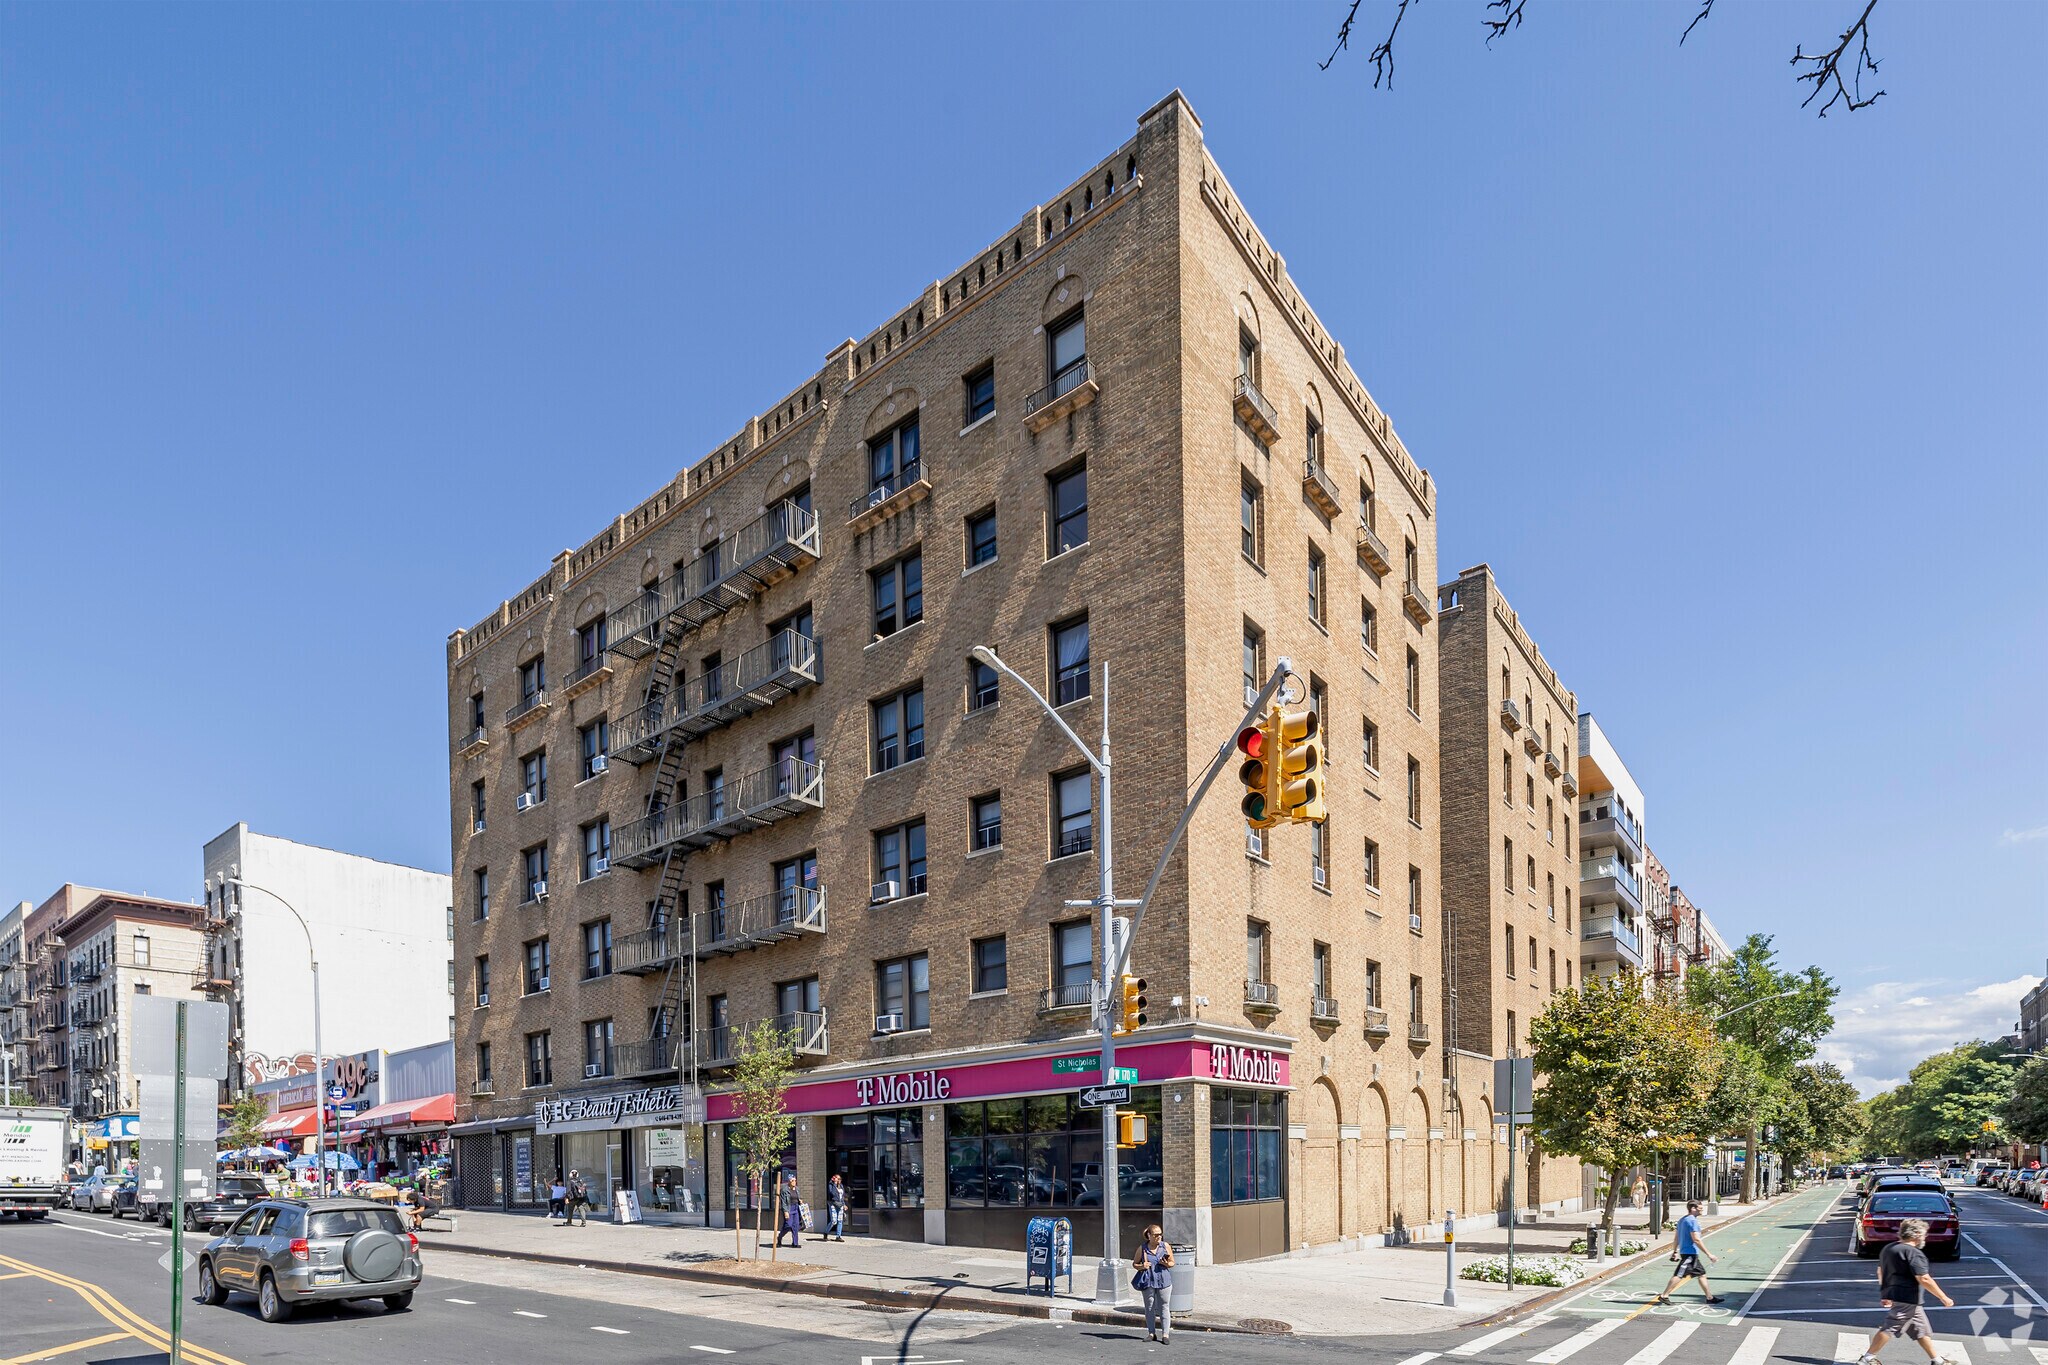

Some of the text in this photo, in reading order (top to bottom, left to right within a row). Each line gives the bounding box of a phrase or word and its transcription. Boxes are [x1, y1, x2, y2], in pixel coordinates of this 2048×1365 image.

[1057, 1058, 1097, 1068] St Nicholas
[1229, 1046, 1281, 1084] Mobile
[1121, 1069, 1131, 1081] 170
[877, 1070, 950, 1104] Mobile
[1087, 1089, 1125, 1101] ONE WAY
[554, 1088, 676, 1125] EC Beauty Esthetic
